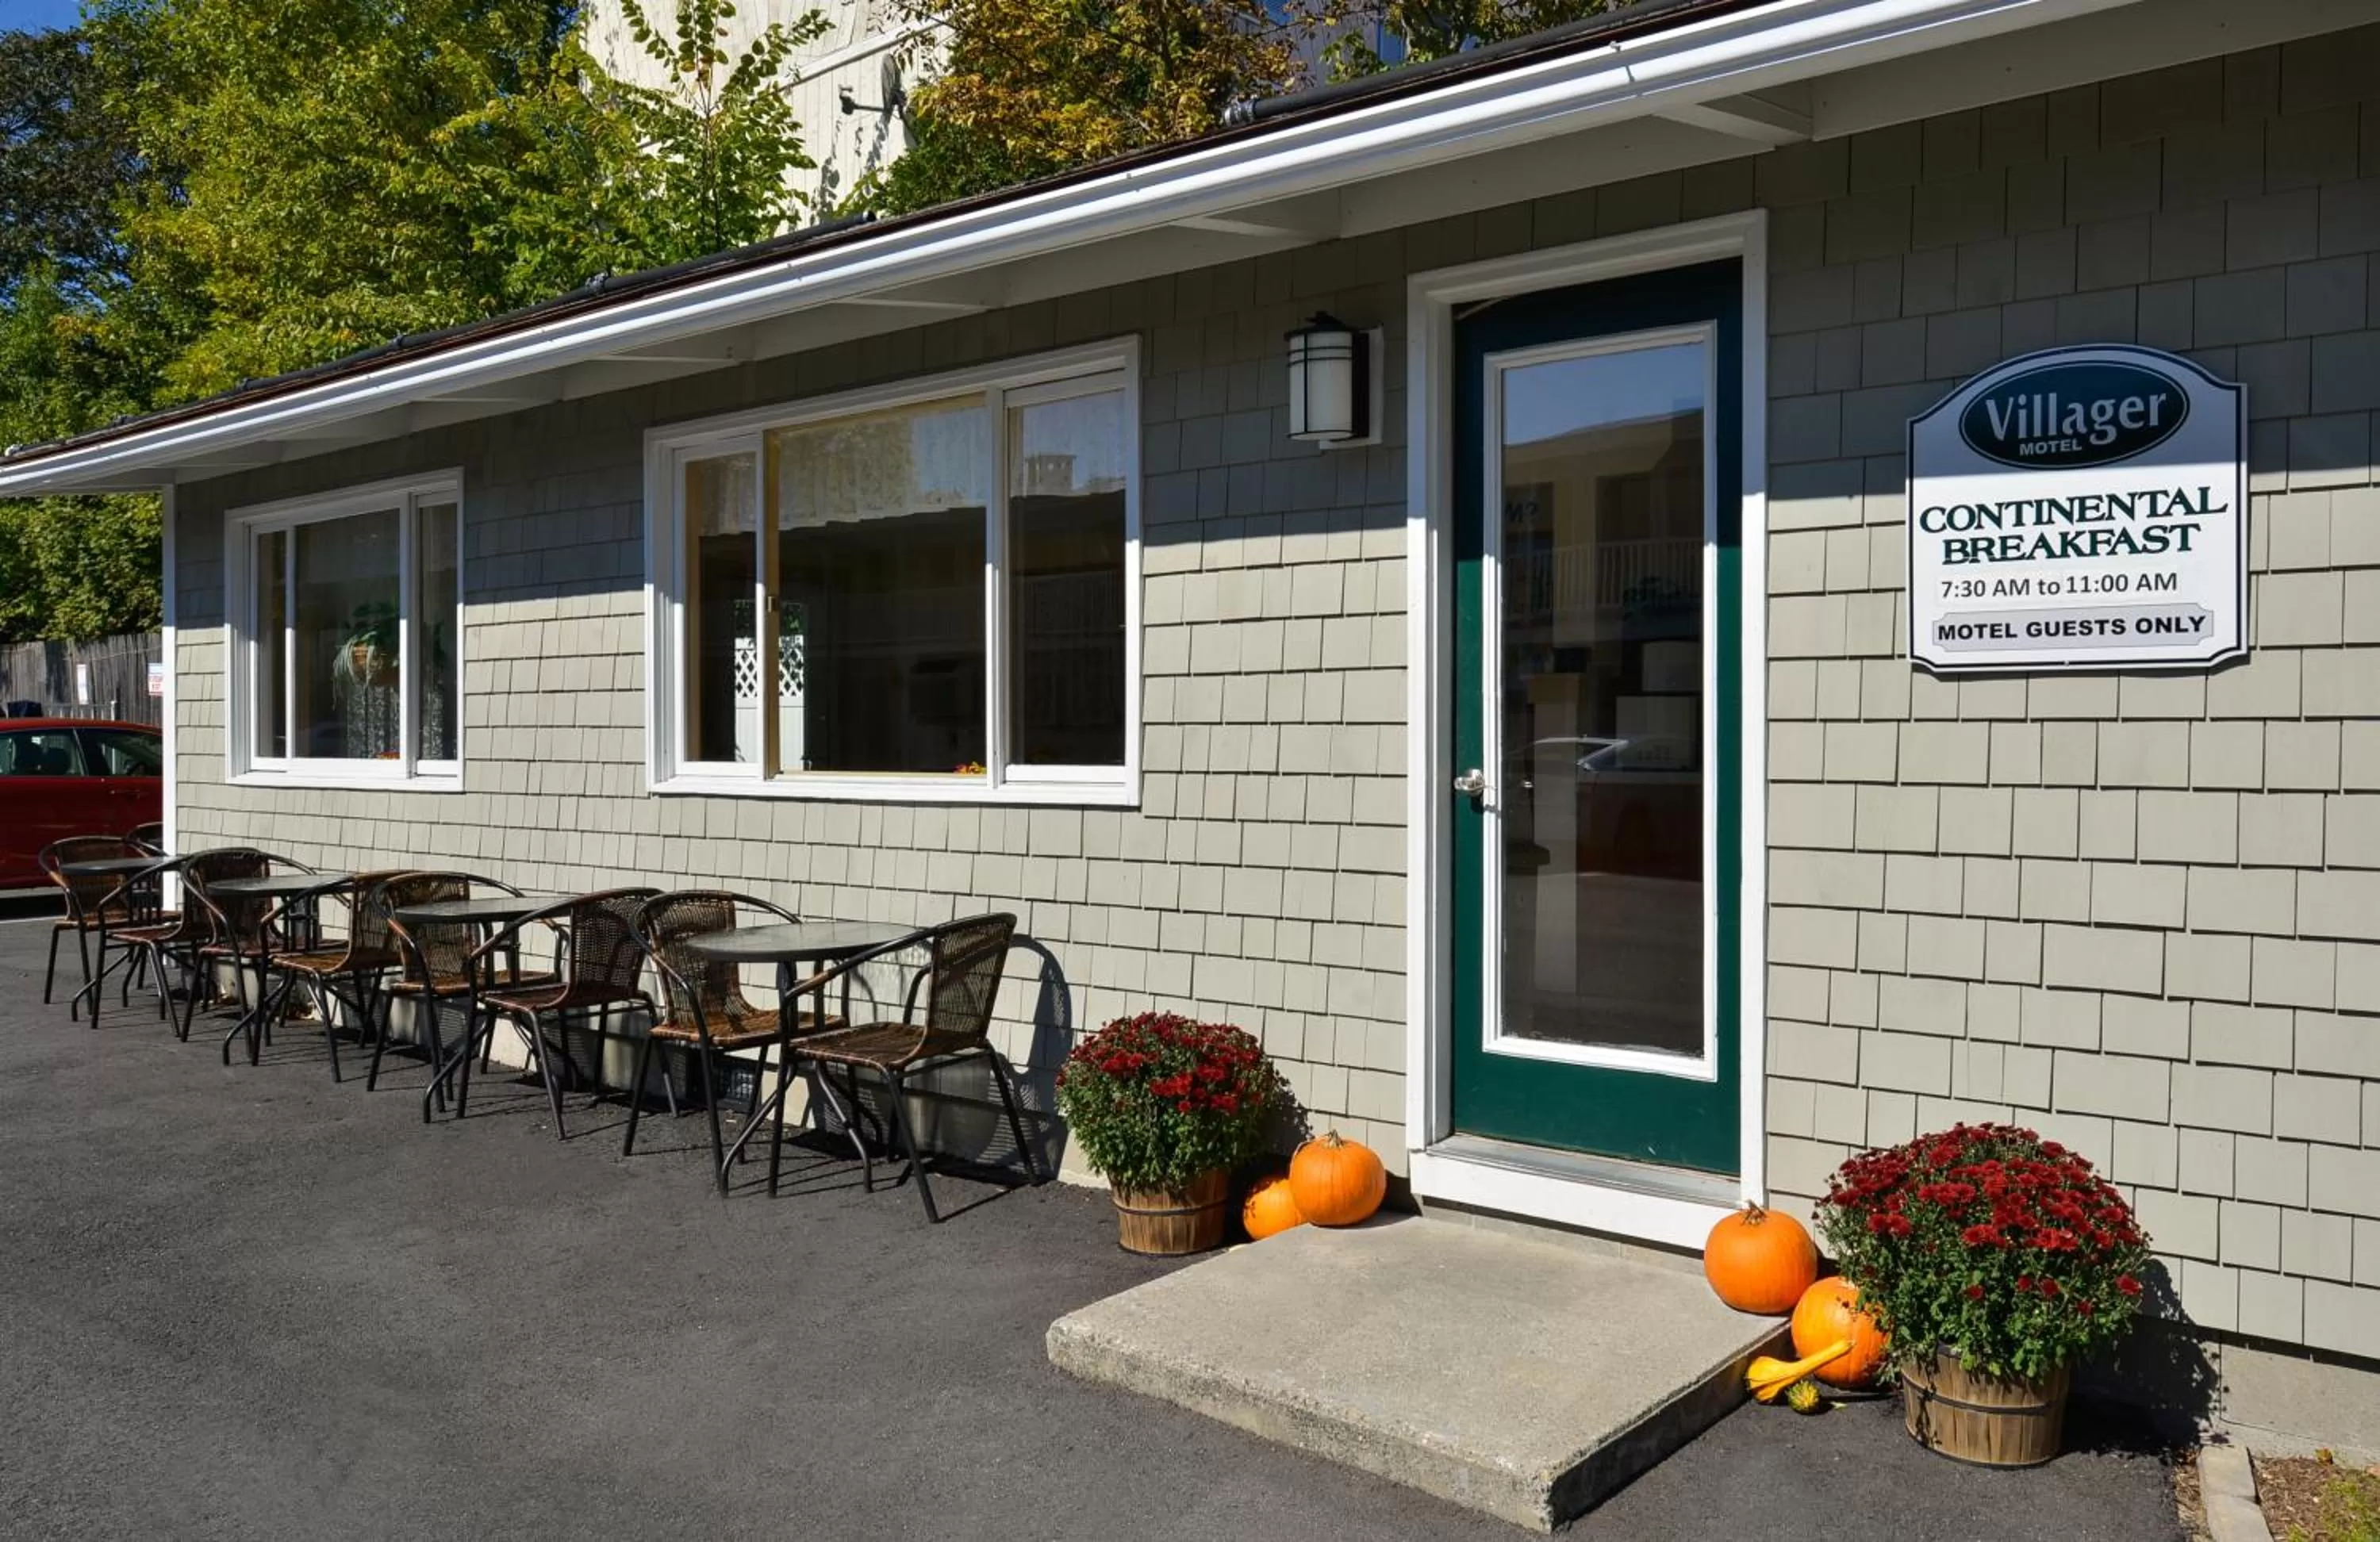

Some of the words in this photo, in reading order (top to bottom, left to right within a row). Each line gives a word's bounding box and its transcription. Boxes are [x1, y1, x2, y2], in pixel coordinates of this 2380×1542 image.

[1986, 392, 2167, 447] Villager
[2019, 439, 2082, 456] MOTEL
[1920, 485, 2228, 533] CONTINENTAL
[1942, 523, 2202, 565] BREAKFAST
[1941, 580, 1986, 598] 7:30
[1992, 577, 2031, 596] AM
[2037, 578, 2061, 596] to
[2066, 574, 2129, 593] 11:00
[2136, 572, 2178, 592] AM
[1937, 622, 2017, 640] MOTEL
[2025, 618, 2127, 638] GUESTS
[2135, 615, 2207, 635] ONLY
